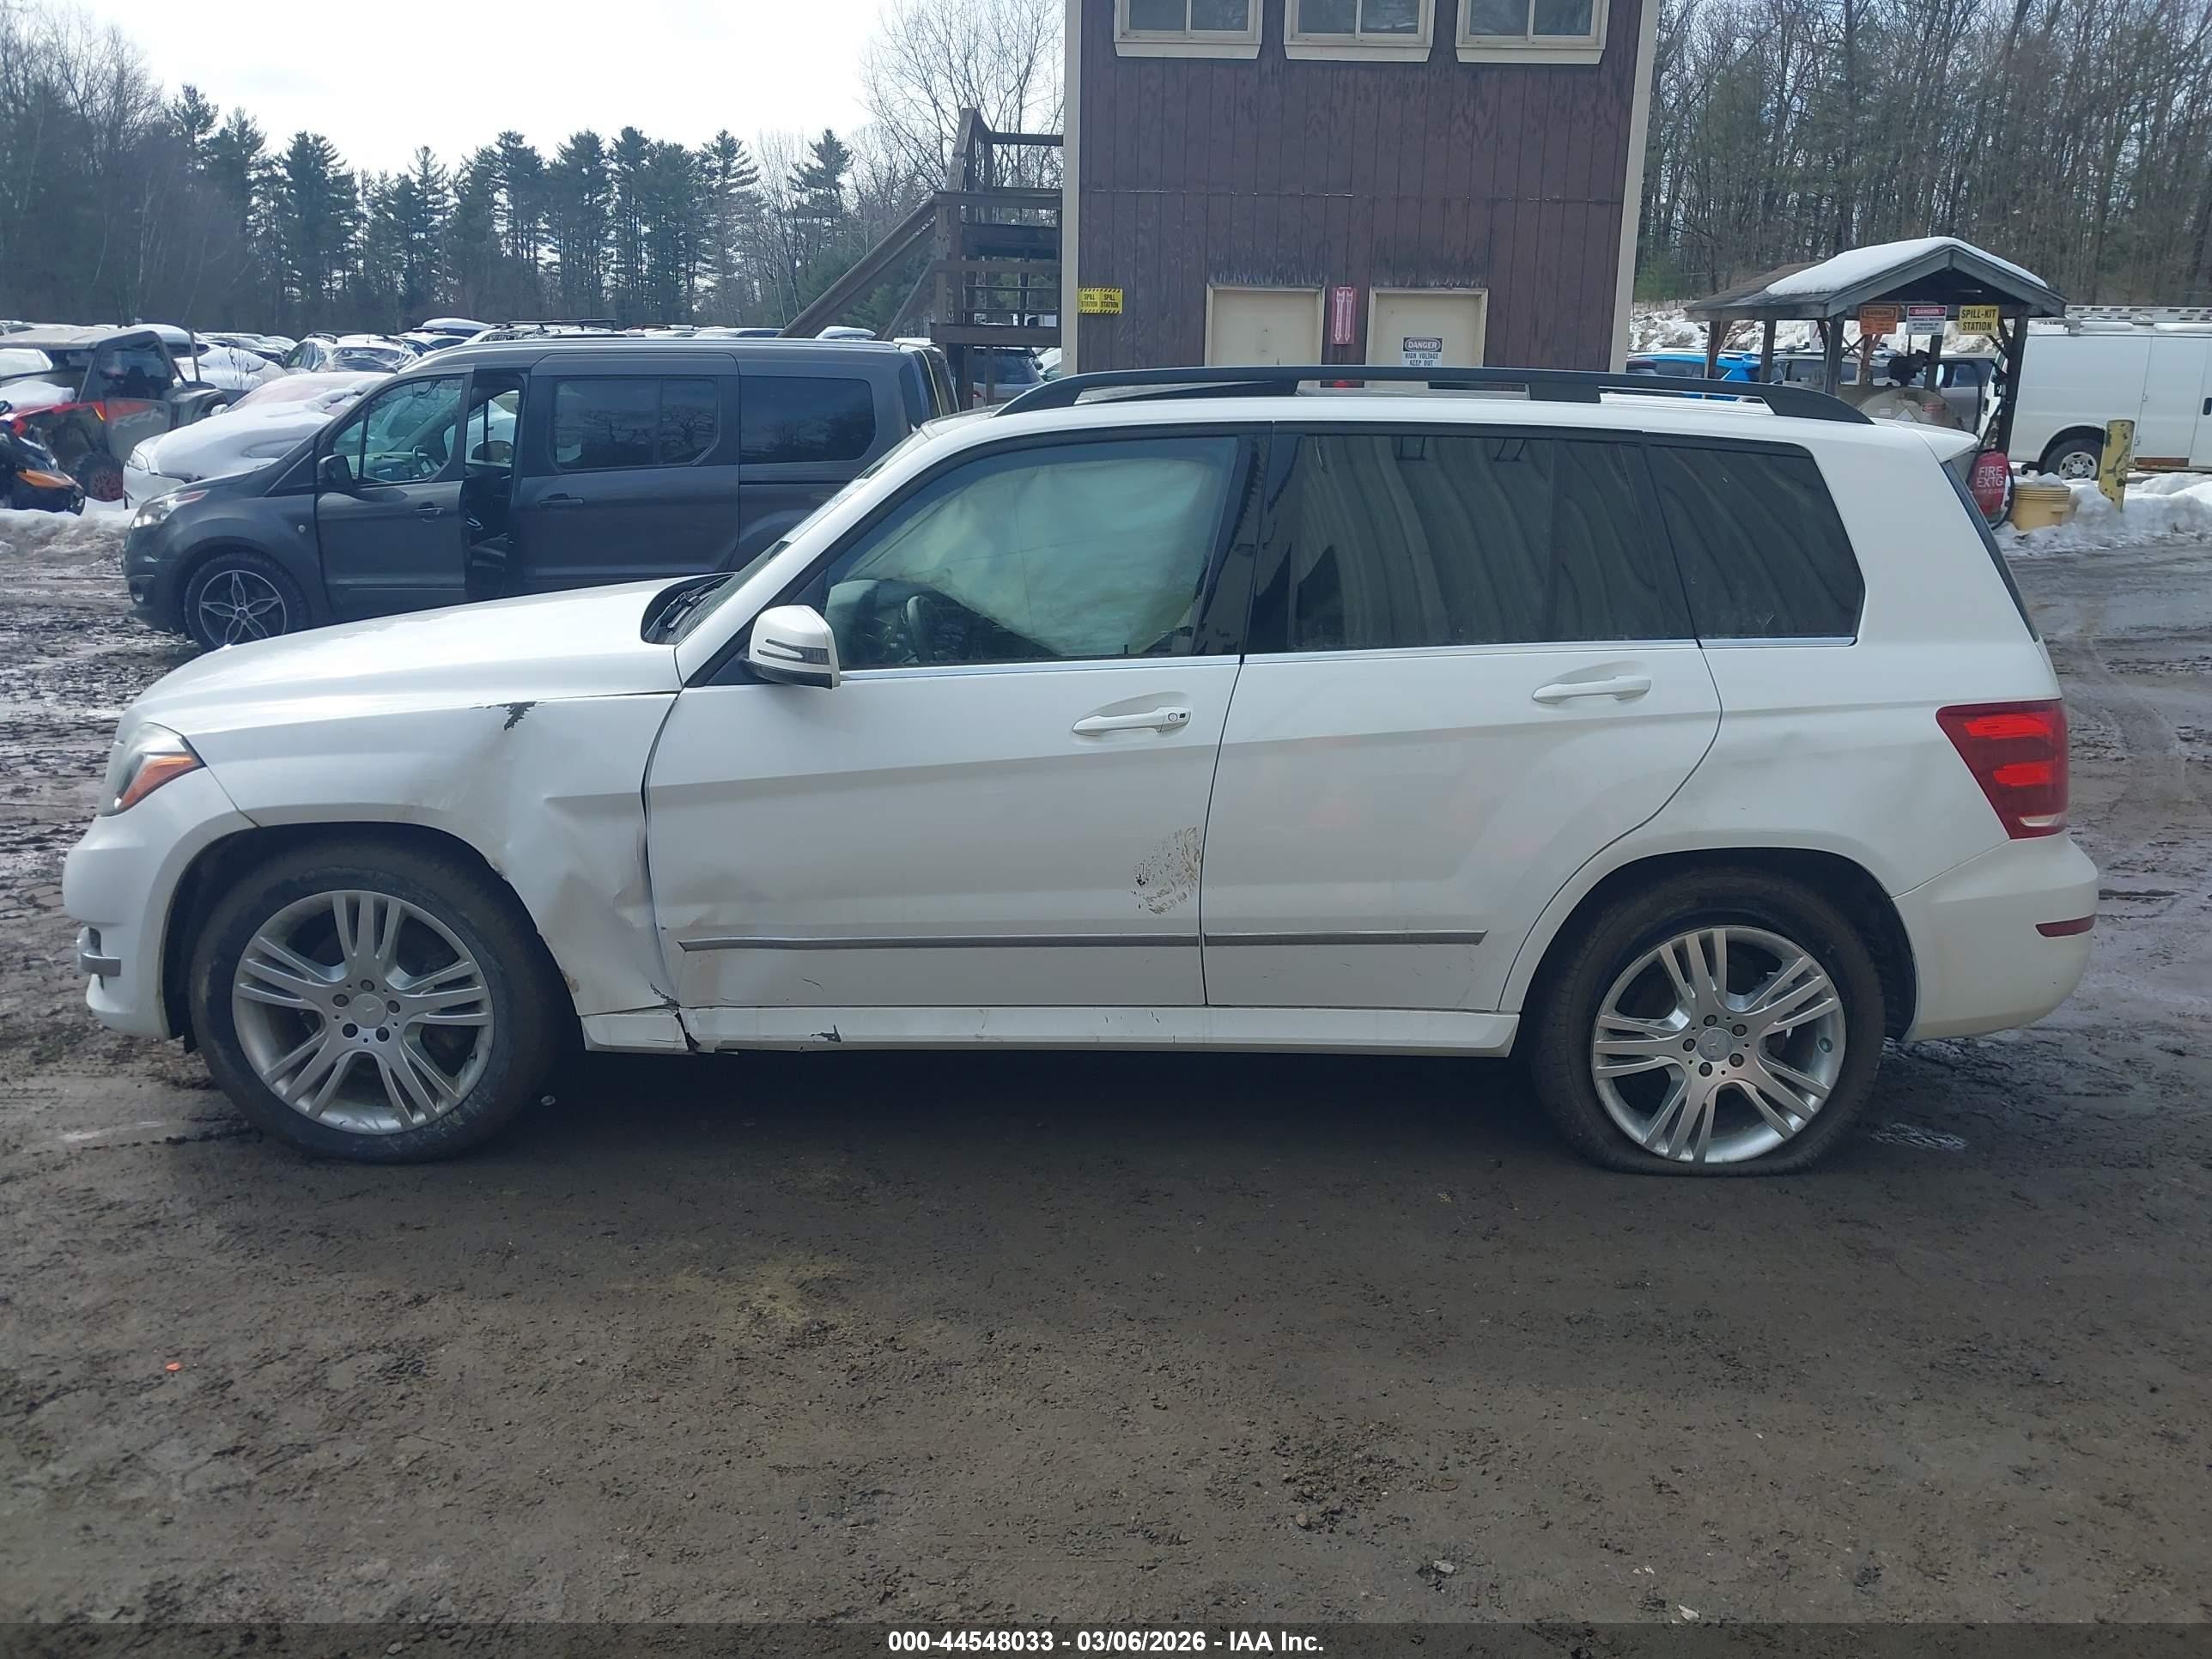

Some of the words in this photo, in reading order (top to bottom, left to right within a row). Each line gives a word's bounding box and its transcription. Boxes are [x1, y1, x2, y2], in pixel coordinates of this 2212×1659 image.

[1961, 309, 1996, 319] SPILL-KIT
[1962, 321, 1992, 331] STATION
[1978, 466, 2003, 477] FIRE
[1977, 477, 2004, 488] EXTG
